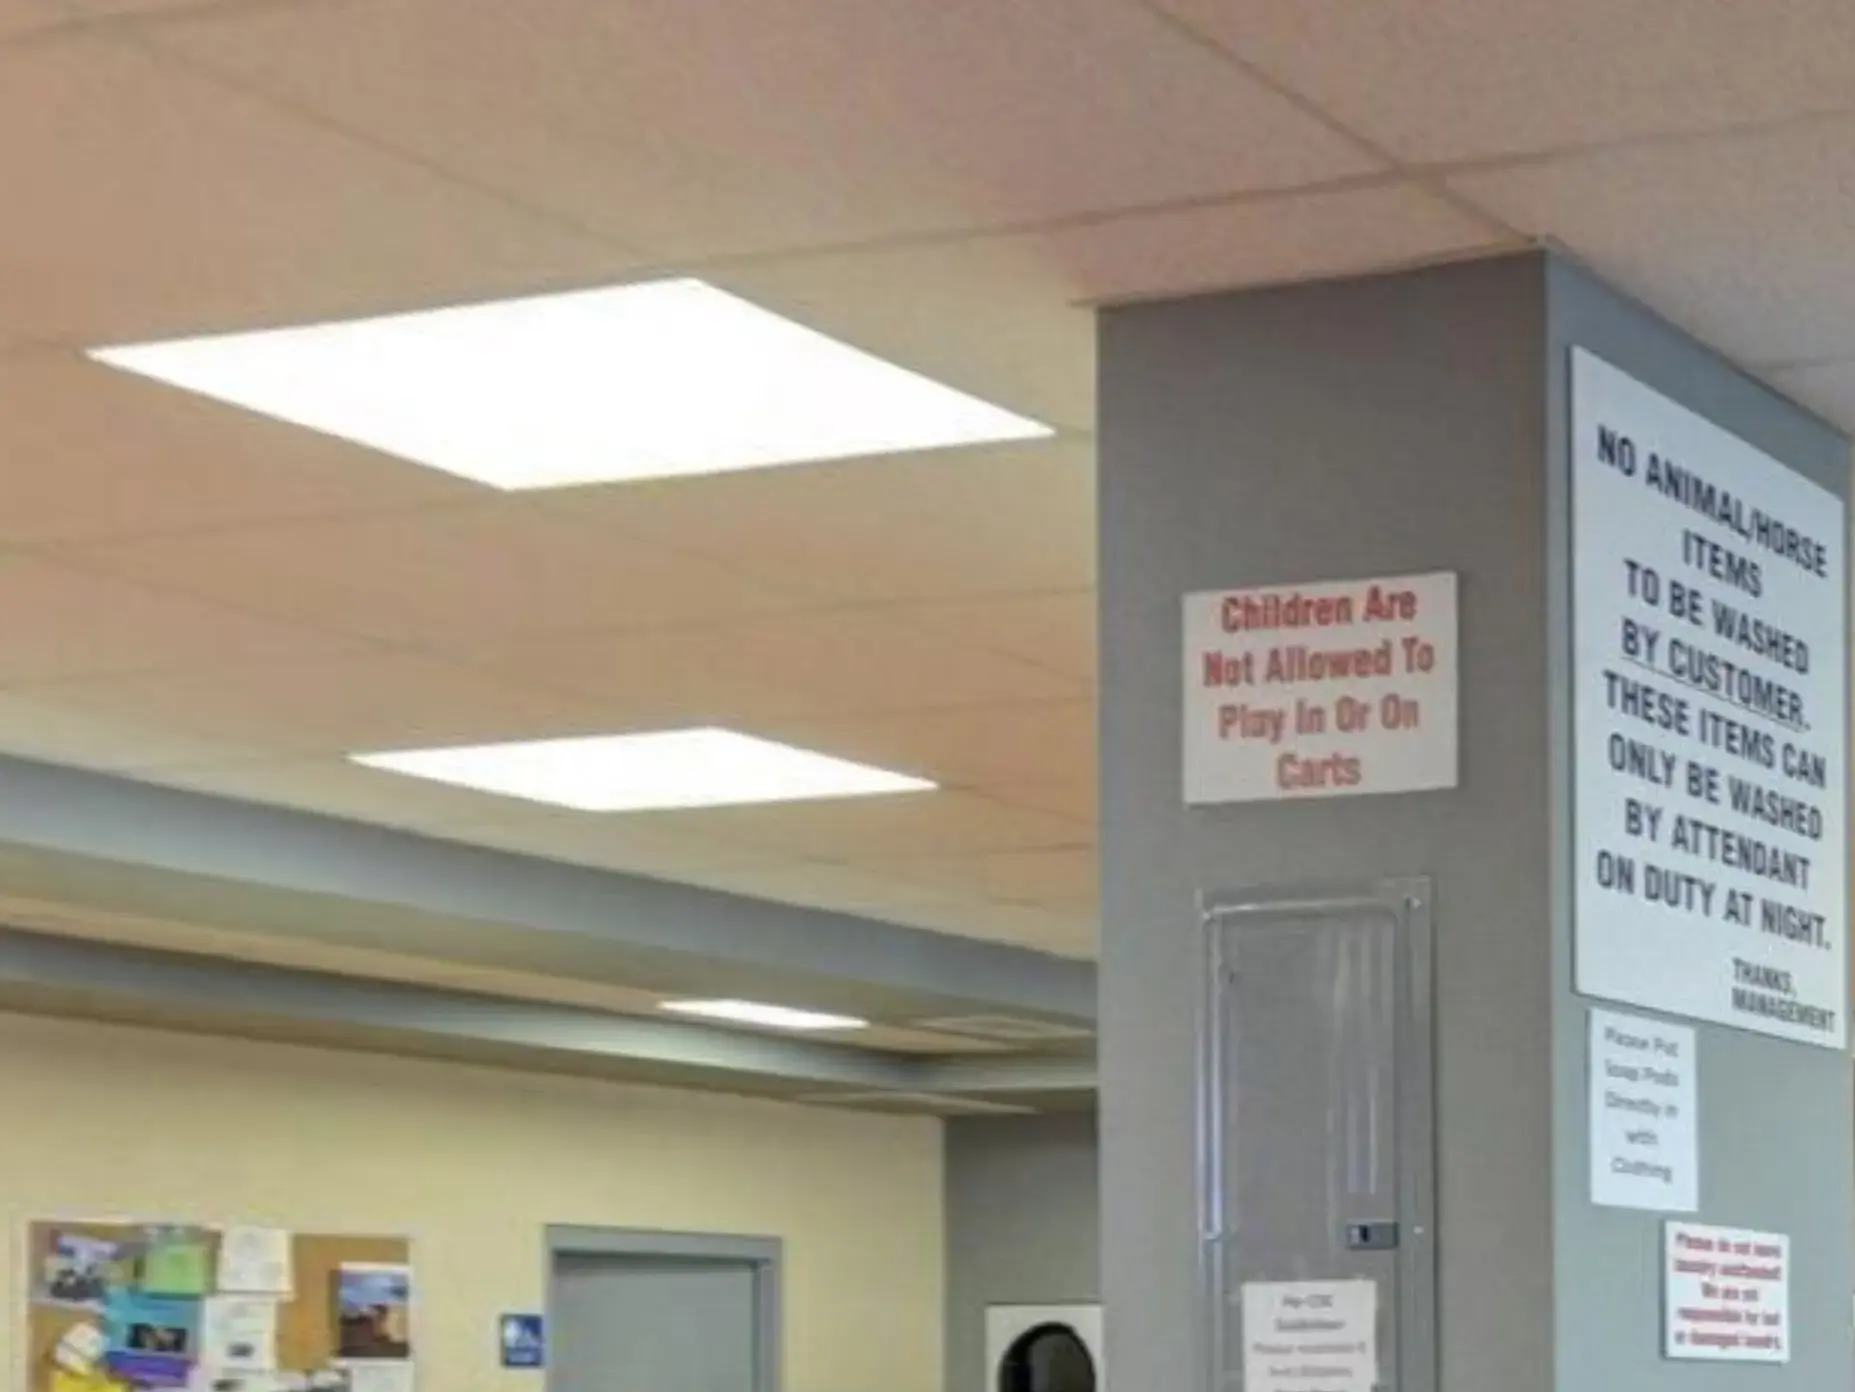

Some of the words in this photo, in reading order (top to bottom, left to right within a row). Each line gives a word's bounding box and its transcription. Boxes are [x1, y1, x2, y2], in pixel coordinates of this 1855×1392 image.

[1597, 423, 1636, 477] NO
[1645, 451, 1828, 578] ANIMAL/HORSE
[1682, 529, 1762, 598] ITEMS
[1221, 592, 1353, 633] Children
[1363, 585, 1417, 622] Are
[1624, 558, 1660, 606] TO
[1669, 579, 1703, 626] BE
[1712, 598, 1809, 675] WASHED
[1203, 650, 1253, 687] Not
[1265, 639, 1392, 683] Allowed
[1402, 636, 1435, 672] To
[1621, 616, 1660, 662] BY
[1668, 637, 1811, 730] CUSTOMER.
[1218, 704, 1285, 743] Play
[1296, 698, 1325, 734] In
[1335, 696, 1370, 732] Or
[1380, 692, 1419, 729] On
[1603, 669, 1690, 737] THESE
[1700, 709, 1775, 770] ITEMS
[1782, 742, 1827, 789] CAN
[1276, 752, 1361, 788] Carts
[1608, 732, 1677, 787] ONLY
[1686, 760, 1721, 805] BE
[1727, 774, 1823, 841] WASHED
[1625, 798, 1663, 841] BY
[1671, 814, 1811, 891] ATTENDANT
[1597, 850, 1635, 895] ON
[1644, 864, 1716, 918] DUTY
[1722, 887, 1753, 926] AT
[1760, 897, 1832, 950] NIGHT.
[1604, 1026, 1649, 1050] Please
[1731, 987, 1836, 1033] MANAGEMENT
[1610, 1156, 1673, 1185] Clothing
